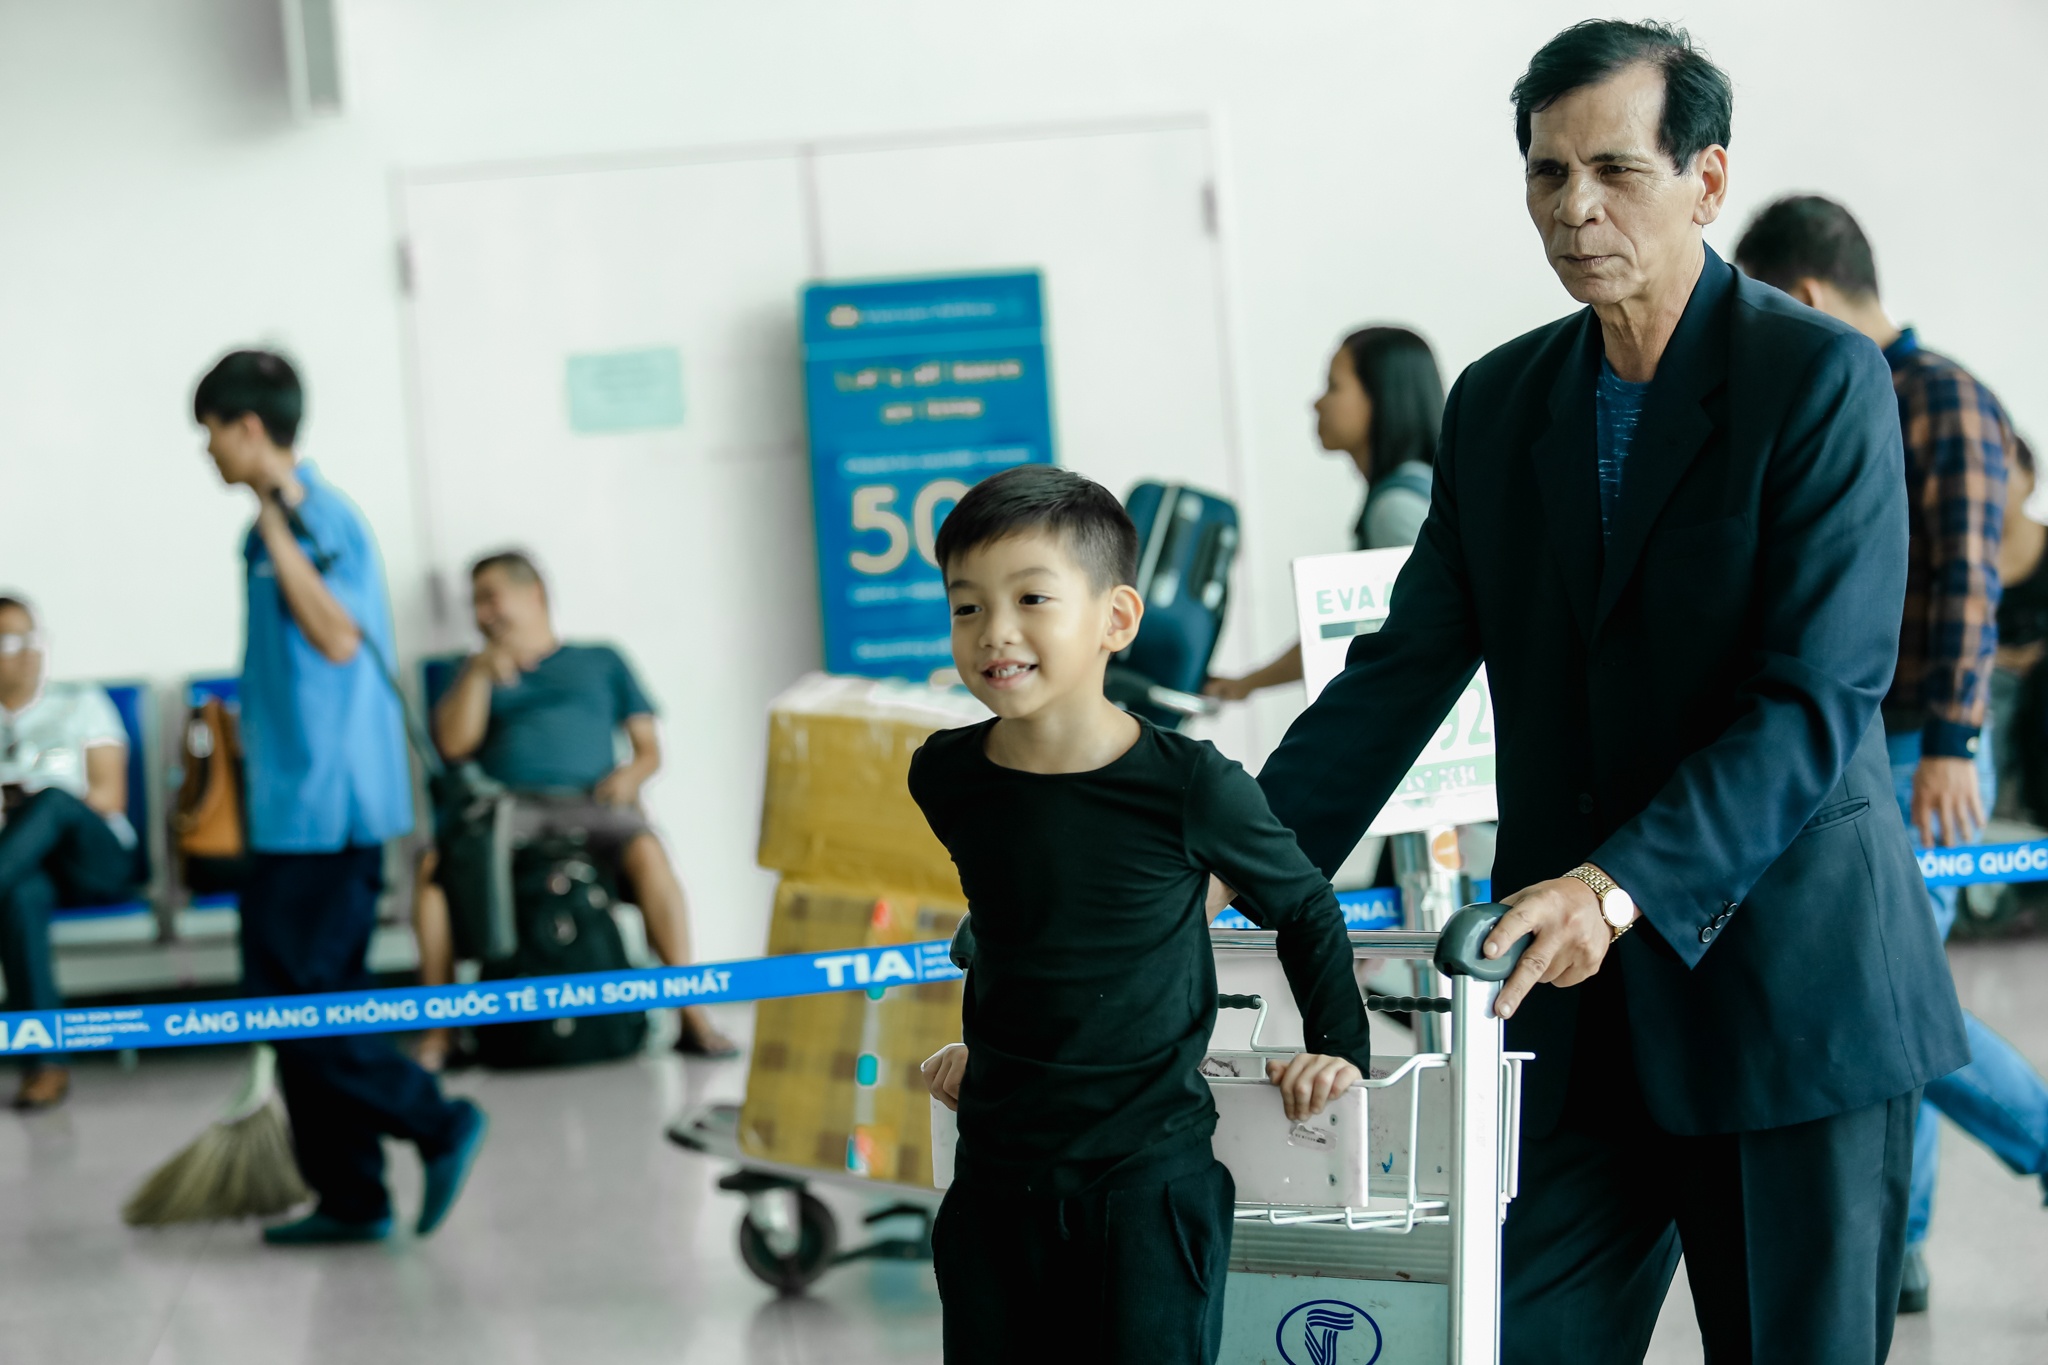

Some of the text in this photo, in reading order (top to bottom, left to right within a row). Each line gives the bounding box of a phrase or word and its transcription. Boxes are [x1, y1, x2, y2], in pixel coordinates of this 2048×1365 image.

[1316, 585, 1375, 615] EVA
[1915, 850, 1975, 878] ÔNG
[814, 949, 915, 987] TIA
[325, 998, 419, 1024] KHÔNG
[601, 979, 658, 1004] SƠN
